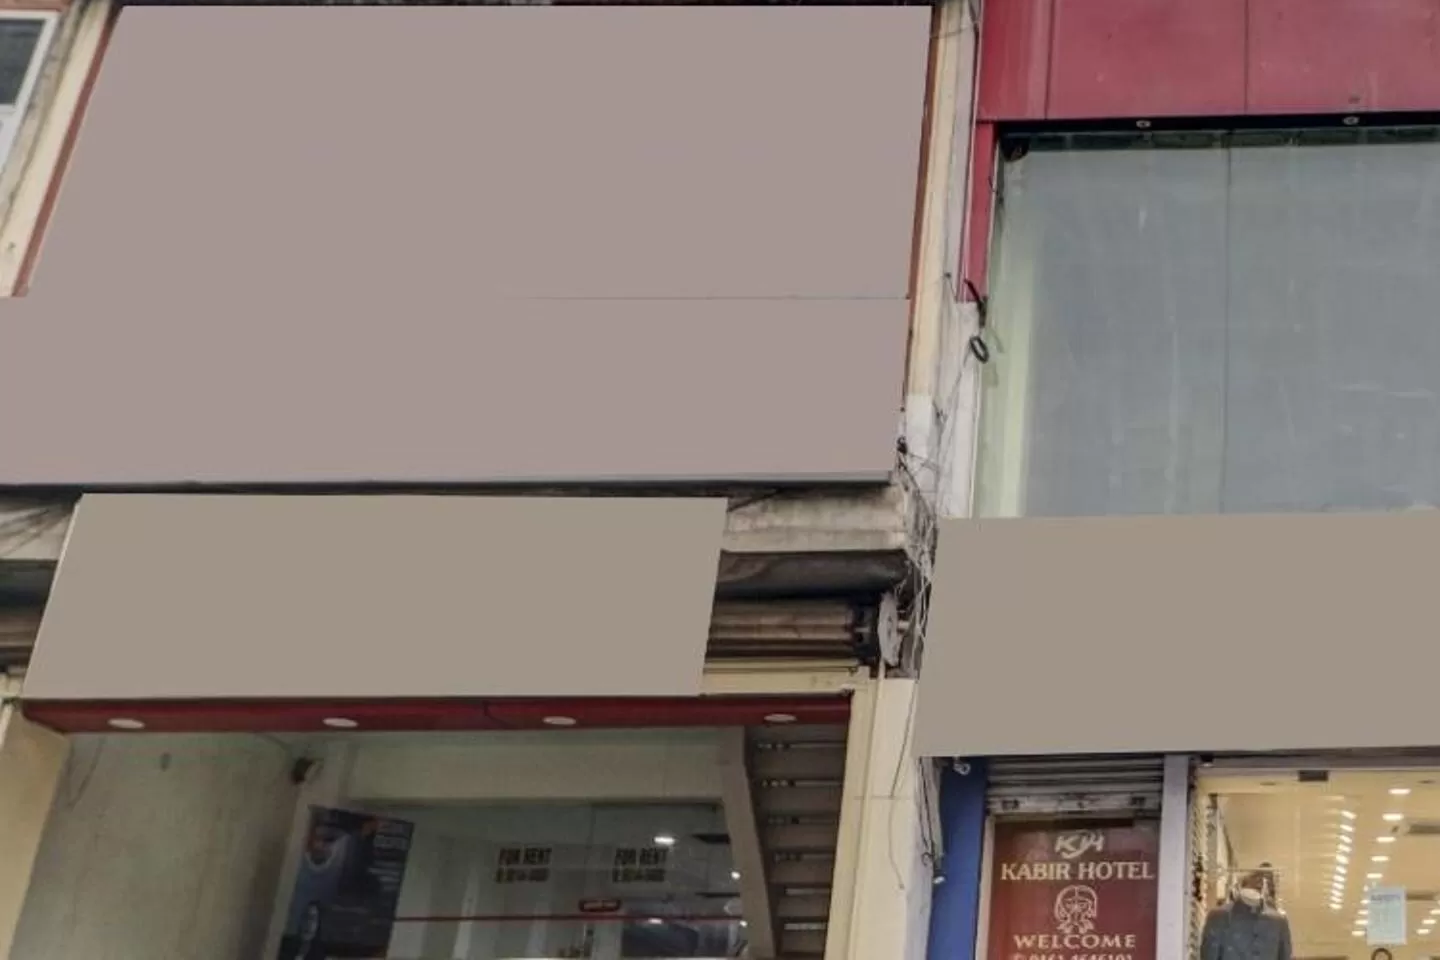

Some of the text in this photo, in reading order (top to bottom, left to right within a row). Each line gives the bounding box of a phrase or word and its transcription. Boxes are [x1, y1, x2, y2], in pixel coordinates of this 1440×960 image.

[1001, 861, 1154, 881] KABIR HOTEL
[1013, 934, 1137, 950] WELCOME
